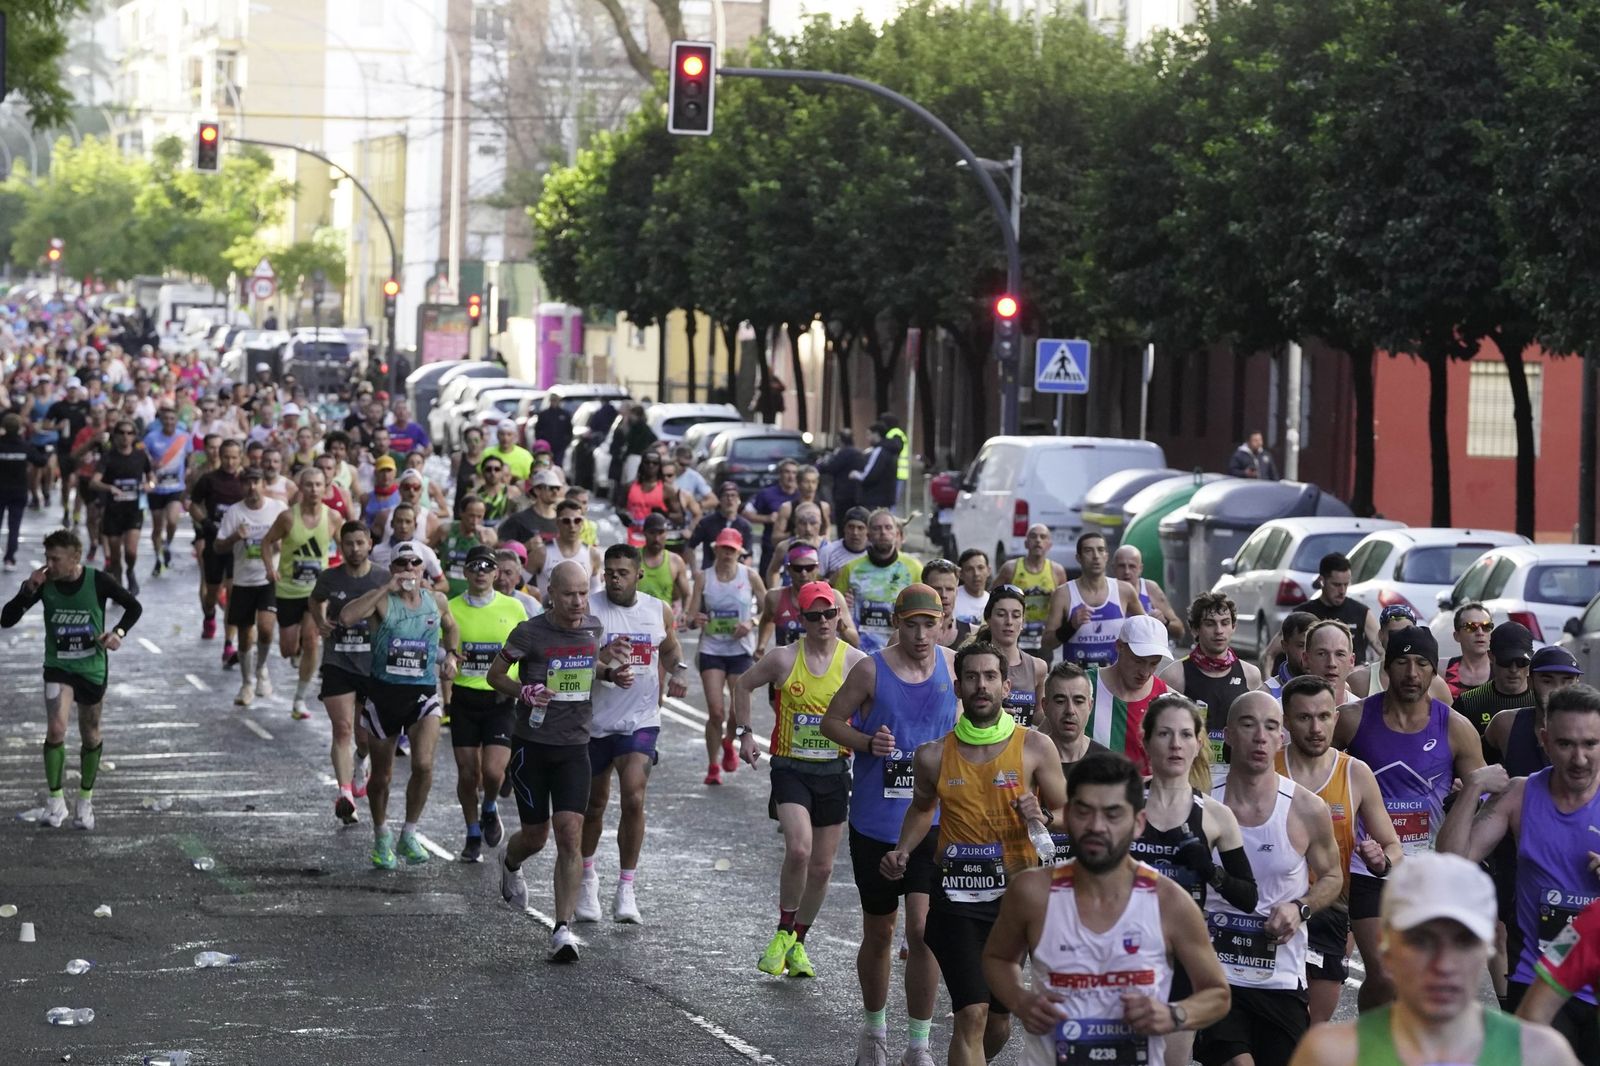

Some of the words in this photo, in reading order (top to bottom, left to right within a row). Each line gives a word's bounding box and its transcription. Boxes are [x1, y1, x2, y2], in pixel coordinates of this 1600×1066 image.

[1078, 634, 1116, 642] OSTRUKA
[69, 643, 83, 651] ALE
[402, 640, 426, 648] ZURICH
[396, 658, 421, 668] STEVE
[564, 660, 589, 668] ZURICH
[559, 682, 581, 691] ETOR
[1010, 693, 1033, 701] ZURICH
[802, 738, 830, 748] PETER
[1387, 802, 1422, 810] ZURICH
[961, 846, 996, 856] ZURICH
[963, 864, 982, 873] 4646
[942, 875, 994, 889] ANTONIO
[998, 874, 1005, 887] J
[1567, 895, 1600, 905] ZUR
[1231, 936, 1252, 947] 4619
[1216, 952, 1277, 969] SSE-NAVETTE
[1088, 1047, 1117, 1061] 4238
